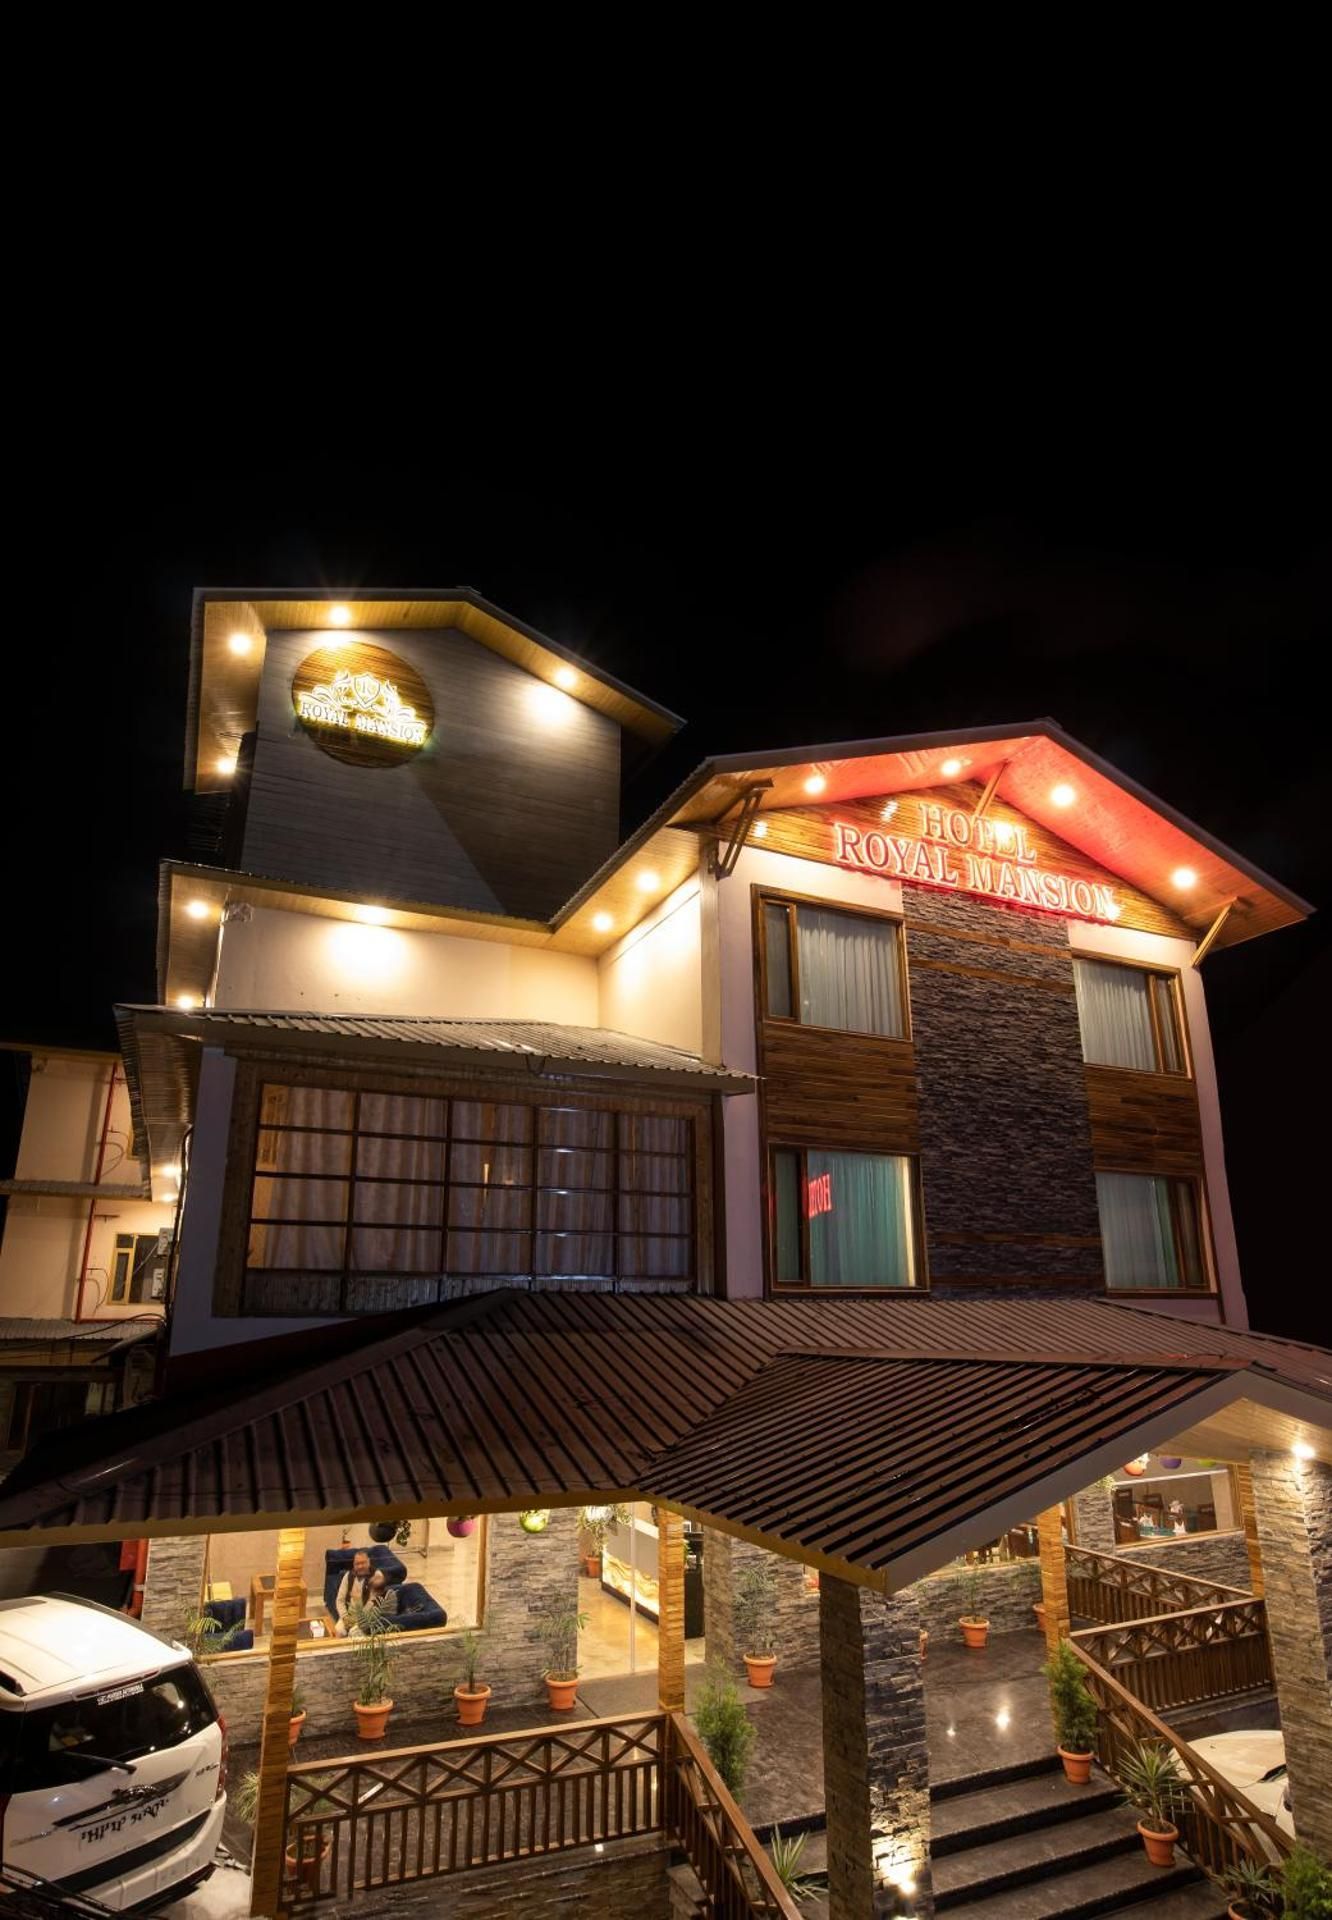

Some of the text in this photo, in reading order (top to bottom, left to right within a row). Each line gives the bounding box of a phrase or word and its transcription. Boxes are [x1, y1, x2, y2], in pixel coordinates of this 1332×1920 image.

[834, 822, 1119, 920] ROYAL MANSION
[919, 802, 1036, 864] HOTEL
